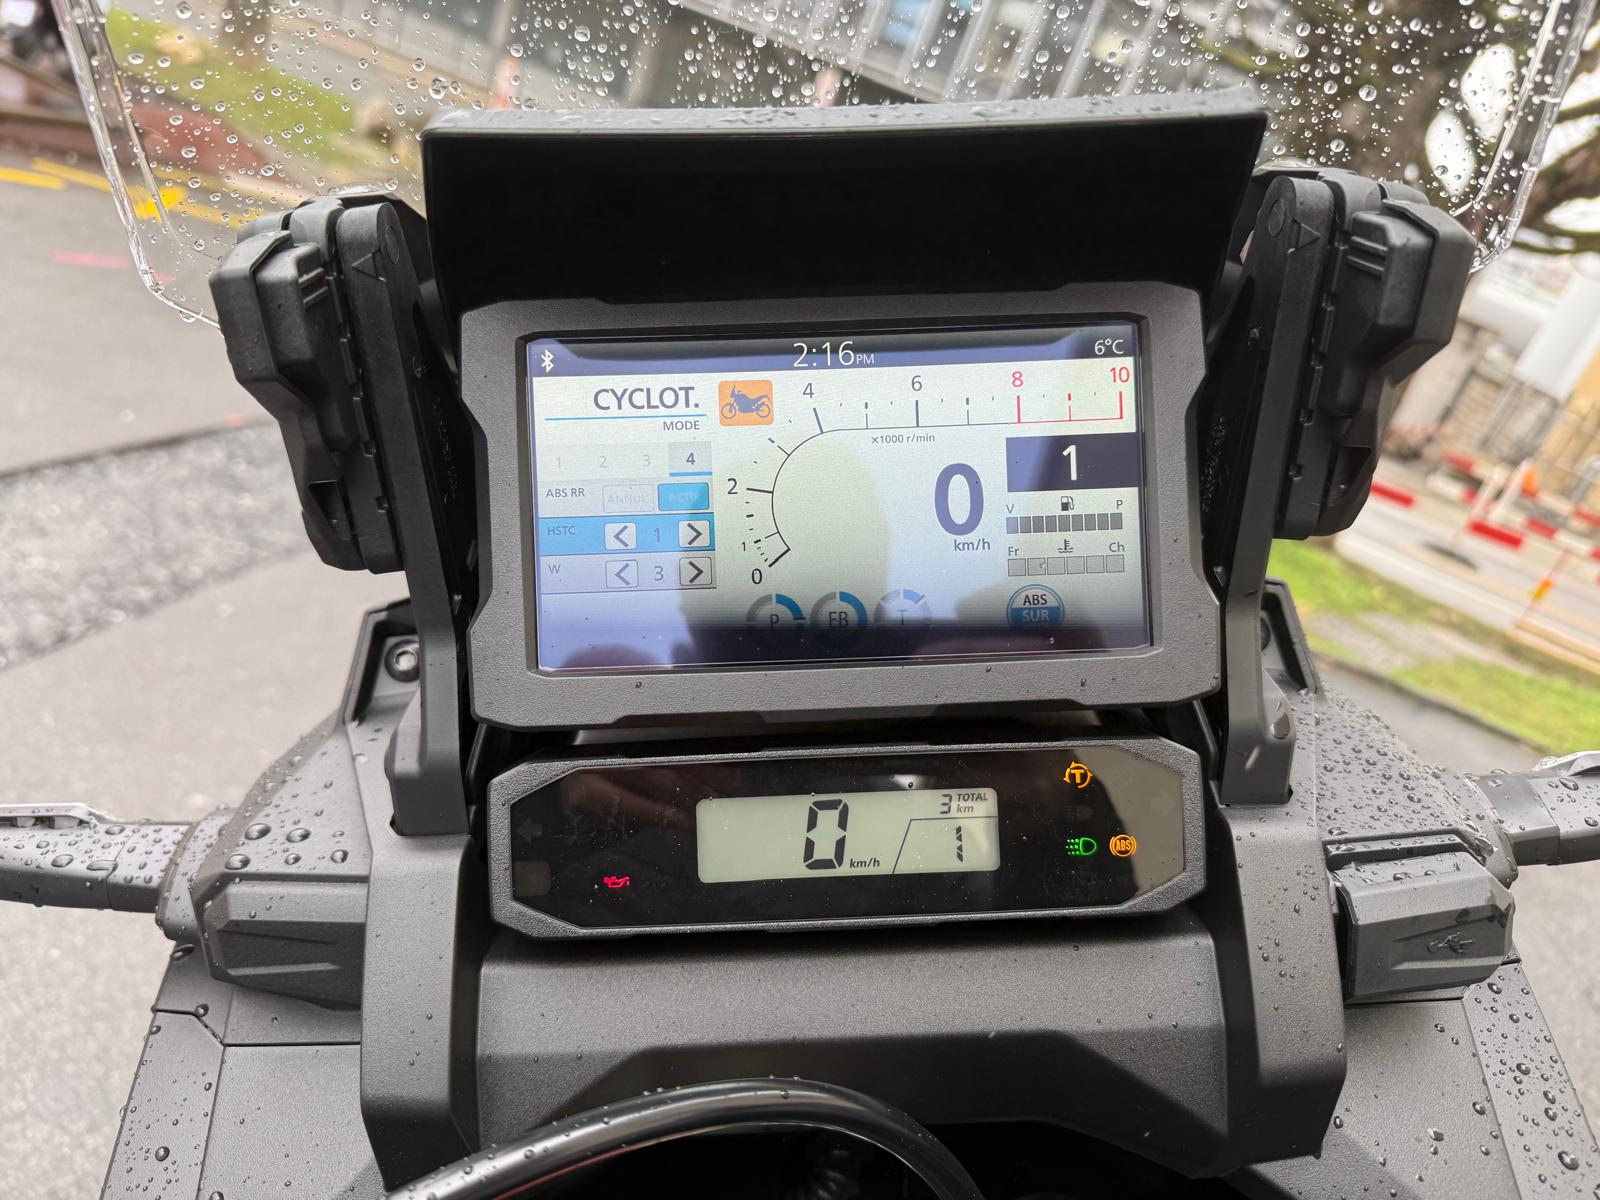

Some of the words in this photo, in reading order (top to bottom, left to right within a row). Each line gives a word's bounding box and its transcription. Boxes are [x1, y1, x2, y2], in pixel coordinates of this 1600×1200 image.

[1094, 339, 1125, 355] 6°C
[793, 341, 854, 367] 2:16
[856, 353, 875, 365] PM
[1011, 371, 1024, 388] 8
[1109, 366, 1130, 383] 10
[802, 382, 815, 398] 4
[911, 375, 923, 392] 6
[593, 386, 700, 411] CYCLOT.
[663, 420, 700, 431] MODE
[906, 433, 936, 444] r/min
[555, 456, 562, 469] 1
[599, 455, 608, 468] 2
[643, 454, 651, 467] 3
[686, 452, 696, 465] 4
[1062, 444, 1078, 481] 1
[545, 488, 568, 498] ABS
[570, 487, 586, 498] RR
[727, 477, 738, 495] 2
[934, 462, 985, 536] 0
[1115, 499, 1124, 510] P
[1005, 504, 1016, 514] V
[547, 525, 577, 536] HSTC
[653, 527, 662, 543] 1
[741, 541, 747, 552] 1
[954, 538, 991, 551] km/h
[1007, 546, 1020, 556] Fr
[1108, 541, 1125, 553] Ch
[548, 563, 561, 574] W
[653, 565, 664, 582] 3
[751, 568, 763, 585] 0
[1022, 593, 1048, 606] ABS
[769, 614, 780, 629] P
[1022, 609, 1049, 622] SUR
[939, 793, 953, 815] 3
[956, 792, 989, 802] TOTAL
[956, 803, 974, 814] km
[803, 798, 849, 870] 0
[849, 857, 880, 869] km/h
[955, 825, 964, 863] 1
[1115, 839, 1132, 851] ABS
